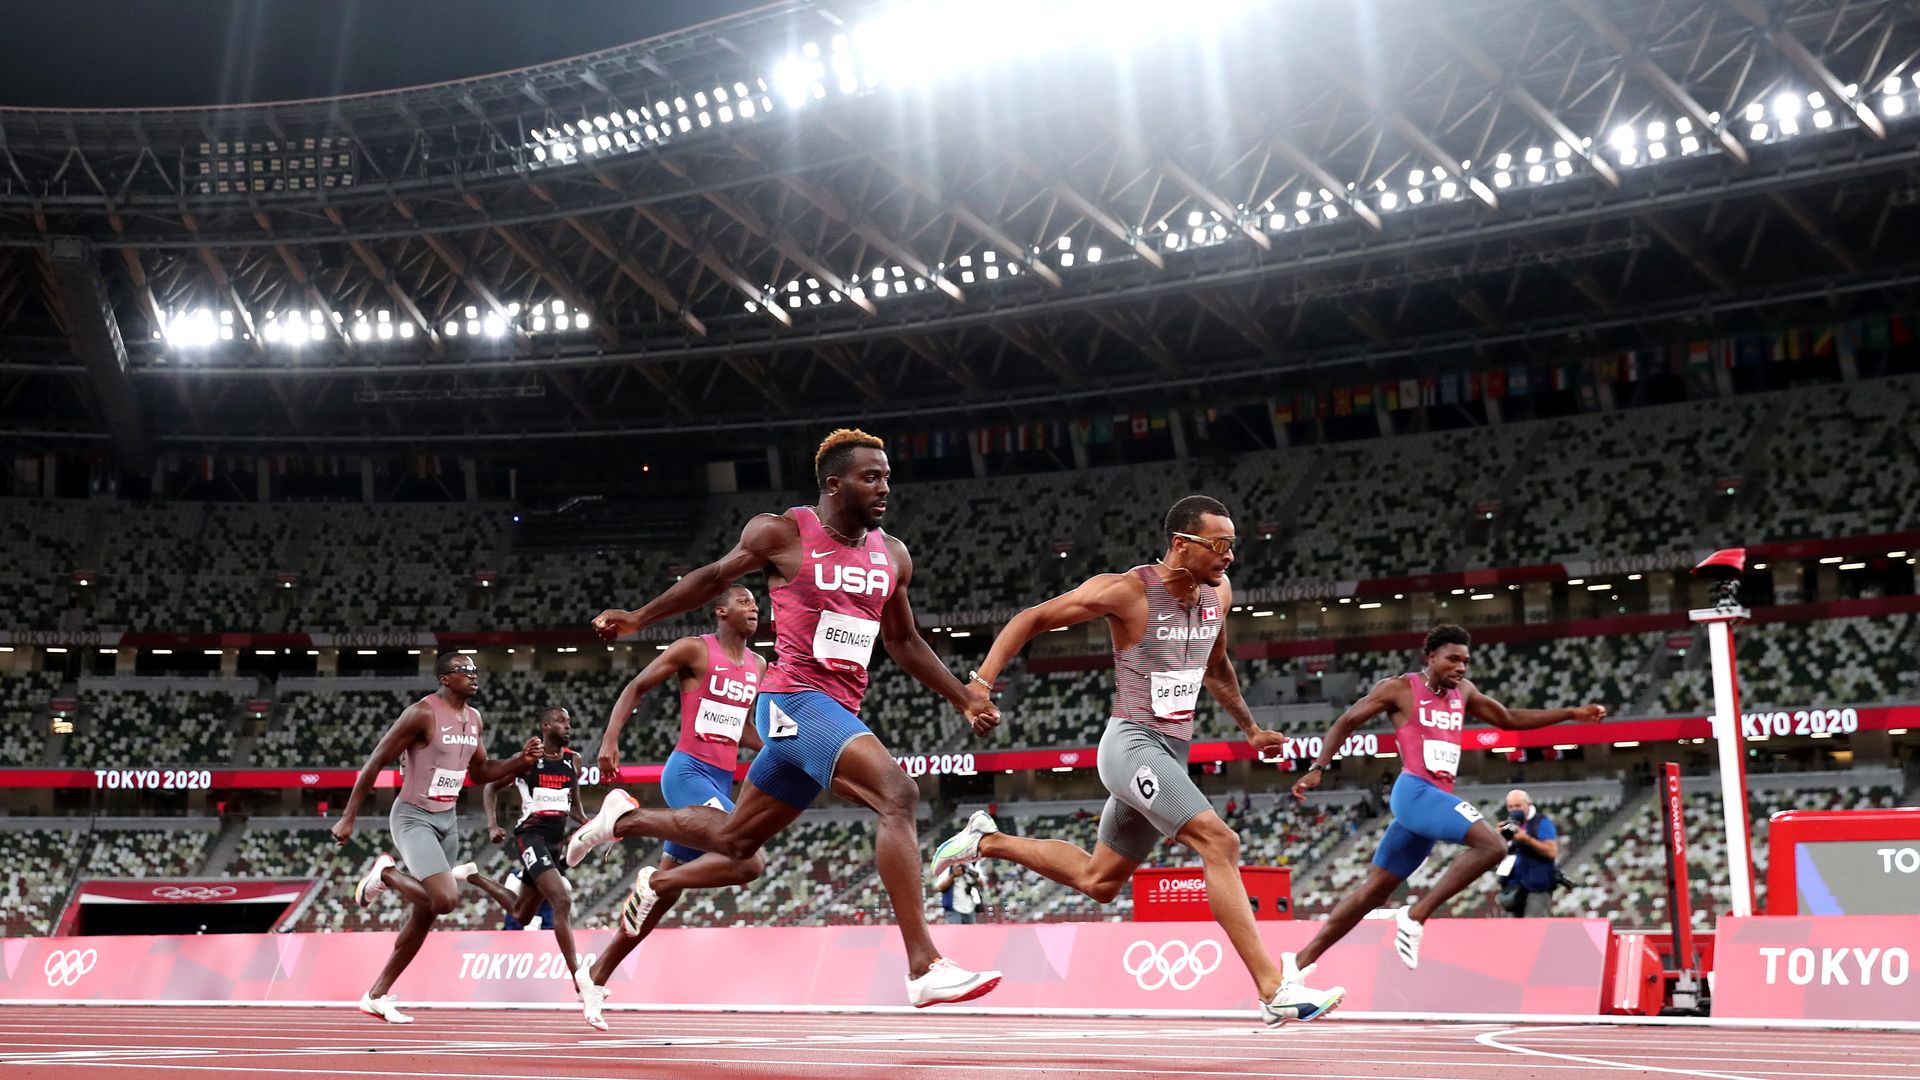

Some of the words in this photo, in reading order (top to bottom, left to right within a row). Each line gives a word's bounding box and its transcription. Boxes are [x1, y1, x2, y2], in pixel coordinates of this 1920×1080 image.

[815, 563, 890, 596] USA
[1156, 625, 1219, 641] CANADA
[709, 674, 757, 705] USA
[1157, 686, 1169, 698] de
[703, 710, 742, 728] KNIGHTON
[1418, 707, 1463, 731] USA
[1707, 712, 1791, 738] TKYO
[1793, 708, 1859, 735] 2020
[1339, 733, 1379, 757] 020
[577, 766, 601, 786] 20
[929, 753, 975, 775] 2020
[94, 769, 160, 790] TOKYO
[162, 769, 212, 790] 2020
[1136, 775, 1156, 800] 6
[1462, 803, 1479, 817] 3
[1671, 796, 1684, 856] OMEGA
[1171, 878, 1207, 890] OMEGA
[459, 953, 534, 980] TOKYO
[1759, 947, 1909, 986] TOKYO
